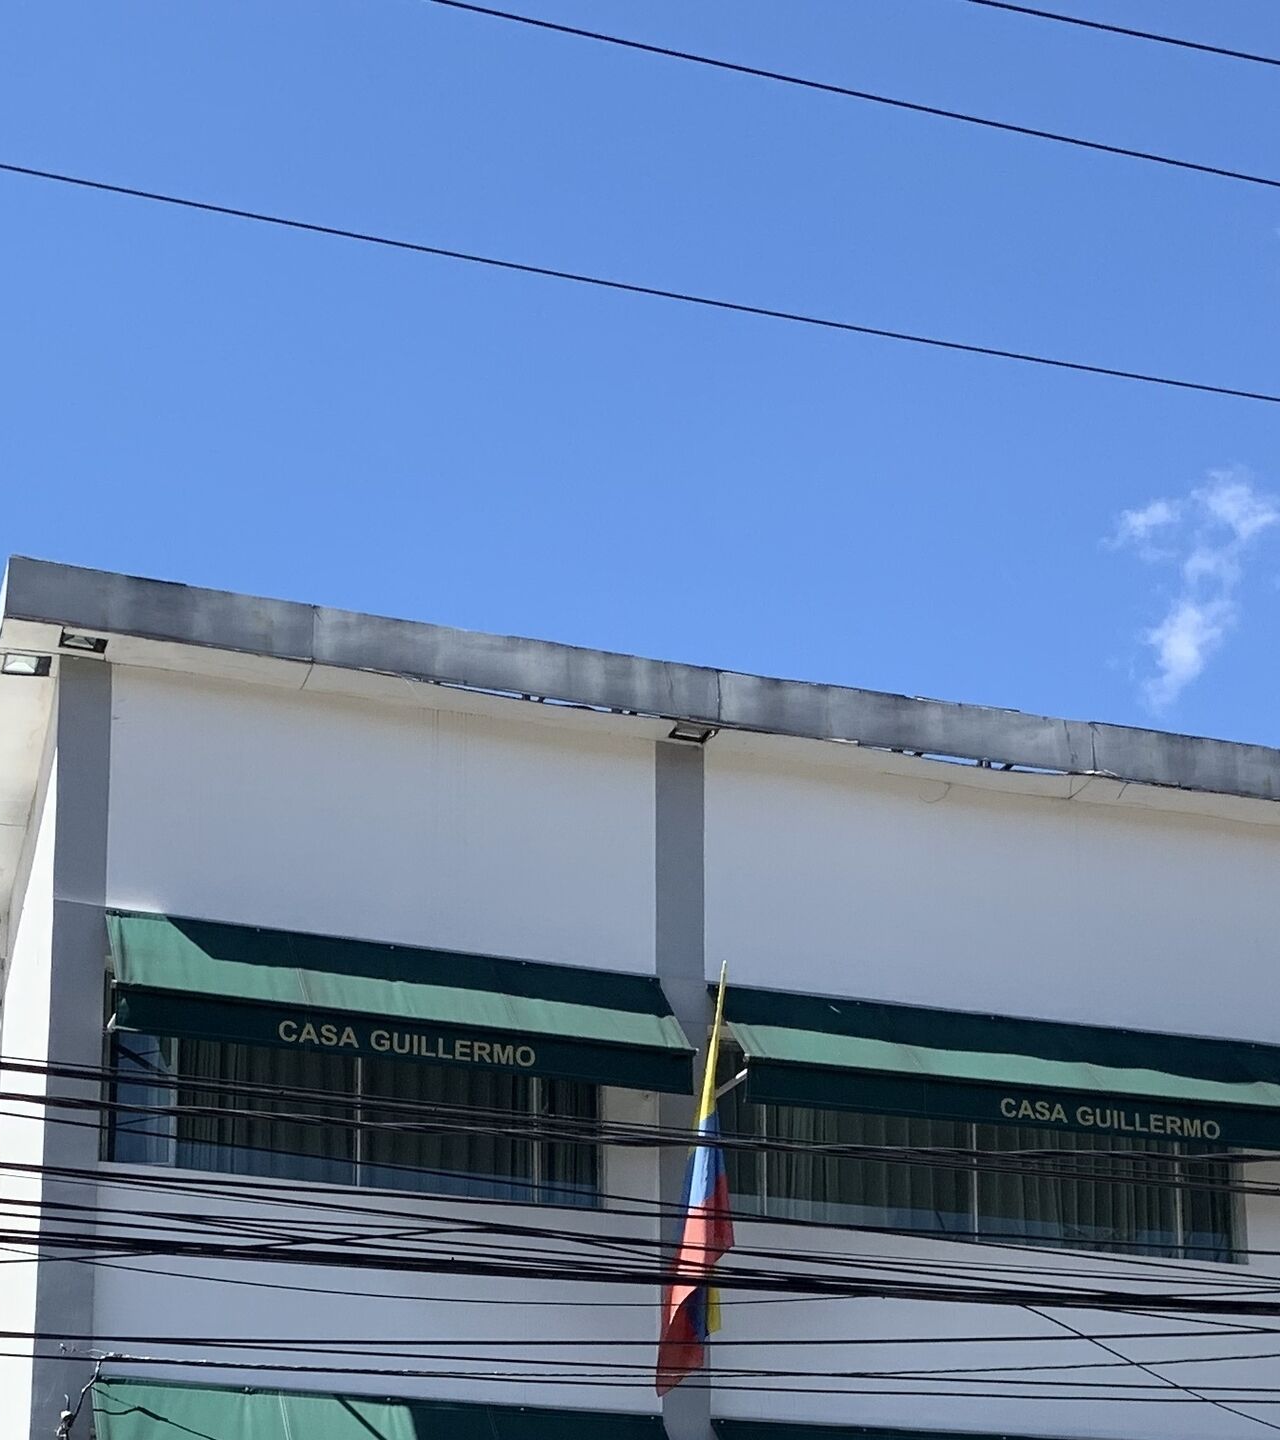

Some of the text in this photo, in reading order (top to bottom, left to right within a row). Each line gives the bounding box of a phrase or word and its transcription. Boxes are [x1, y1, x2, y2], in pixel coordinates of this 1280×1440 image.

[278, 1020, 536, 1067] CASA GUILLERMO
[1000, 1098, 1221, 1140] CASA GUILLERMO
